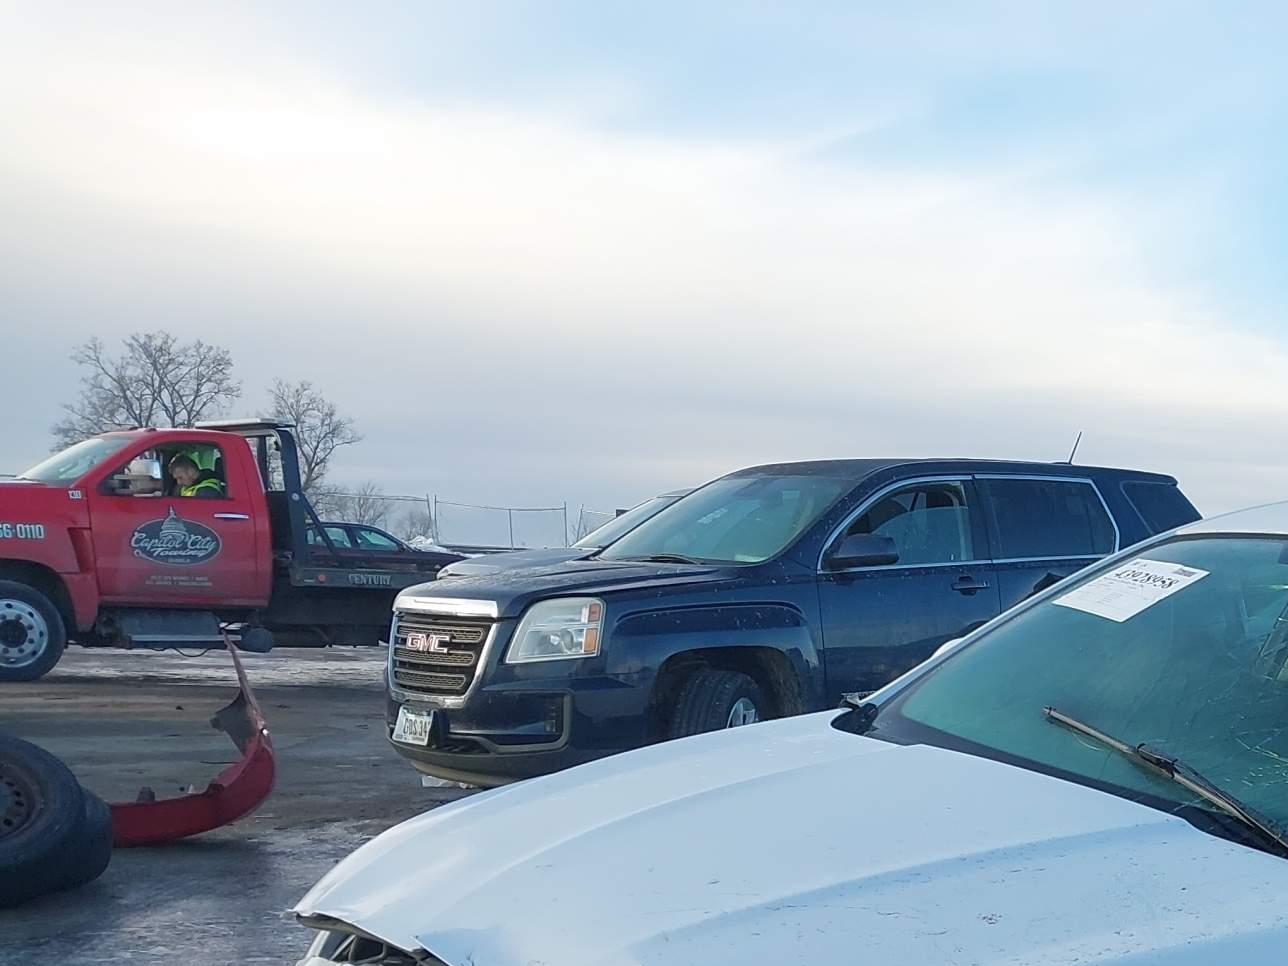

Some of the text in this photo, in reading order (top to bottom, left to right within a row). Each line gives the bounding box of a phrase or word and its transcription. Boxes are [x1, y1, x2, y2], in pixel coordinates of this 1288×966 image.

[131, 532, 216, 554] Capitol City
[150, 547, 207, 558] Towing
[348, 573, 391, 585] CENTURY
[406, 632, 450, 654] GMC
